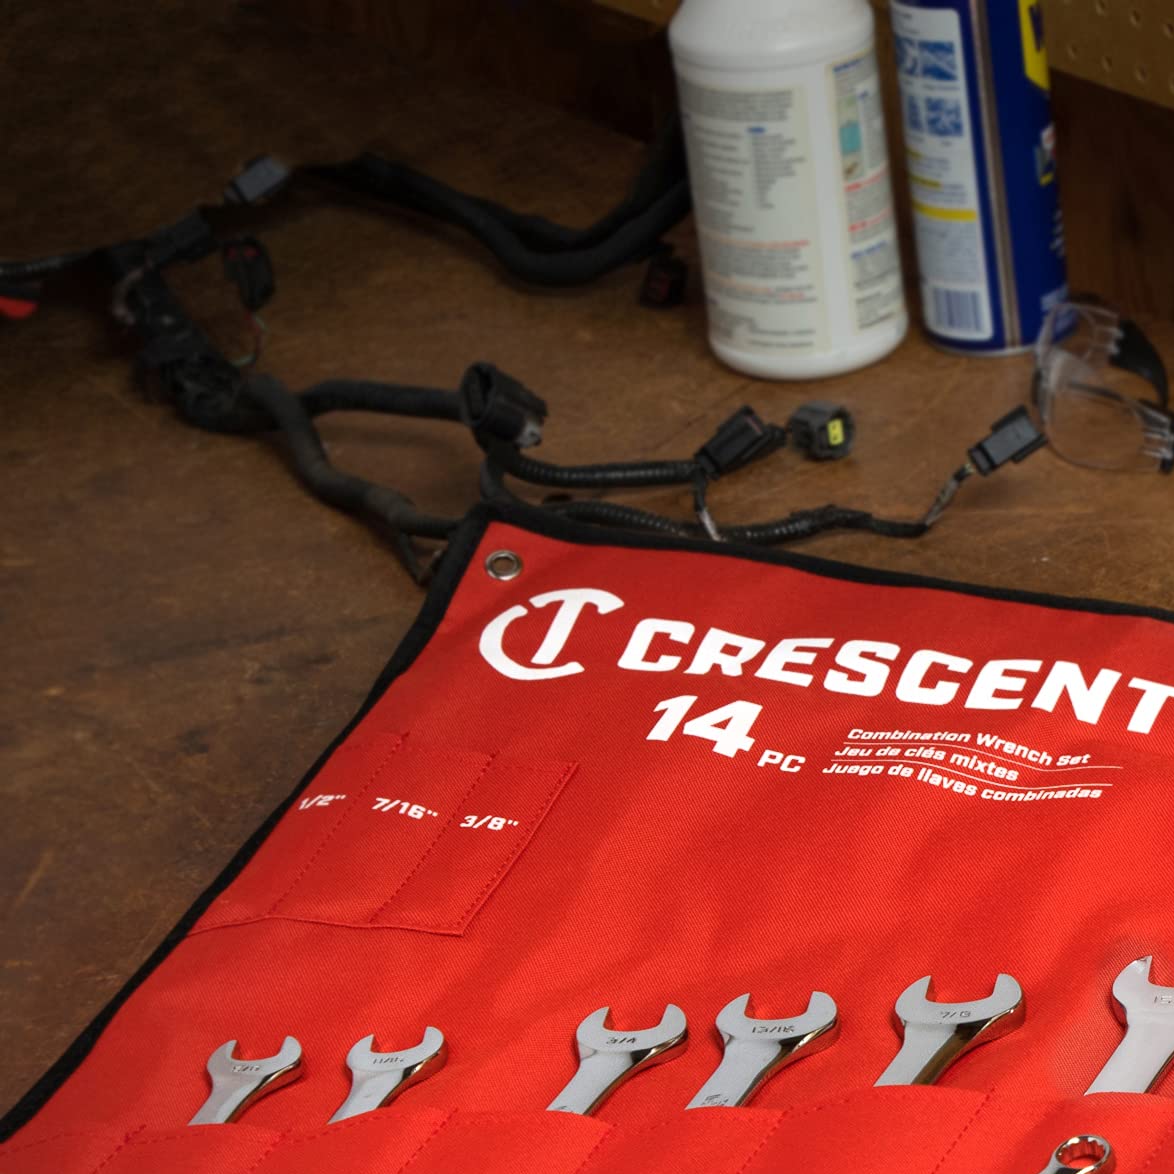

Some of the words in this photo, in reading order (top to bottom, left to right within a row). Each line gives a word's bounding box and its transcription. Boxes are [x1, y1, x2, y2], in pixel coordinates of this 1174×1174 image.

[646, 694, 764, 758] 14
[756, 749, 806, 773] PC
[847, 728, 971, 743] Combination
[975, 731, 1053, 766] Wrench
[1055, 753, 1091, 767] Set
[822, 763, 883, 776] Juego
[888, 763, 914, 778] de
[916, 763, 978, 797] llaves
[980, 786, 1103, 802] combinadas
[834, 746, 872, 757] Jeu
[875, 745, 902, 757] de
[904, 745, 946, 761] clés
[950, 752, 1019, 782] mixtes
[372, 797, 438, 819] 7/16"
[460, 815, 518, 831] 3/8"
